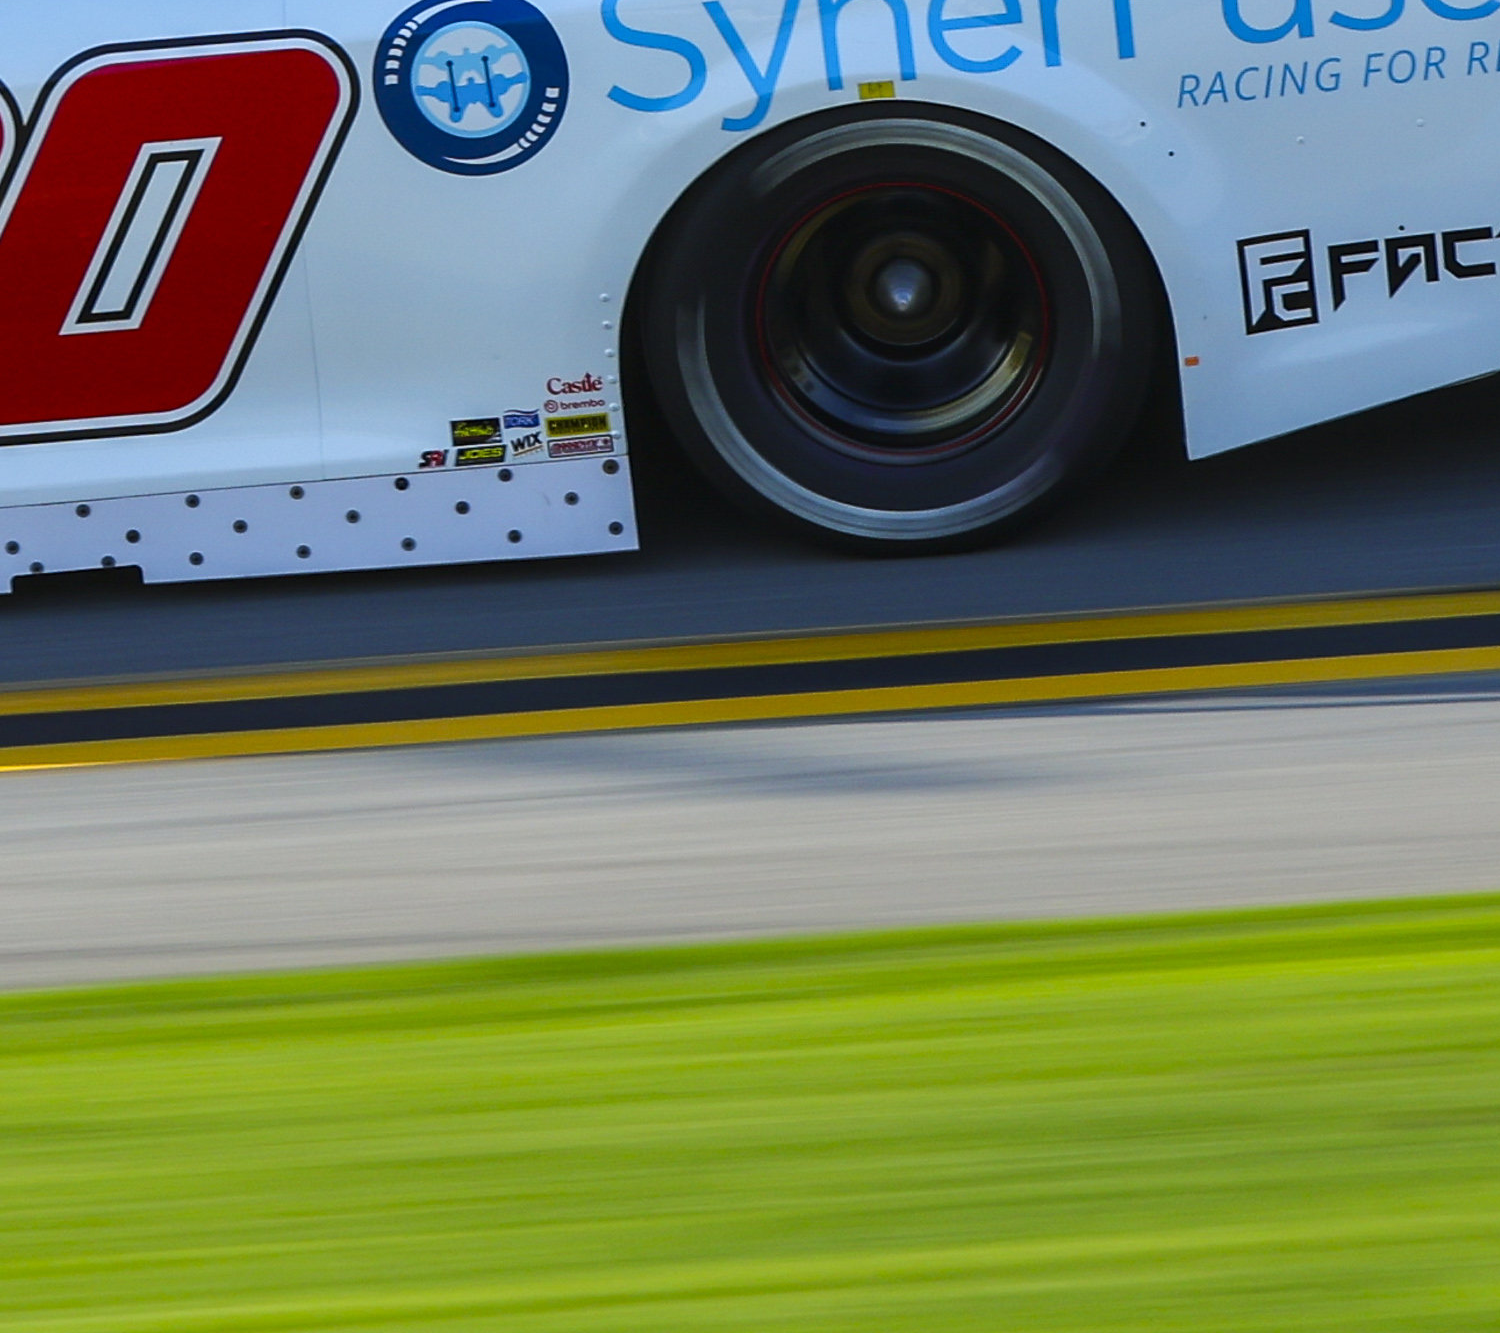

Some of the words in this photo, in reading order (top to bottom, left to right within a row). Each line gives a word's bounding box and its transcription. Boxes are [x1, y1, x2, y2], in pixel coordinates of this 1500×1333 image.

[1177, 56, 1342, 108] RACING
[1362, 46, 1446, 87] FOR
[546, 373, 603, 395] Castle
[560, 399, 605, 410] brembo
[511, 432, 543, 452] WIX
